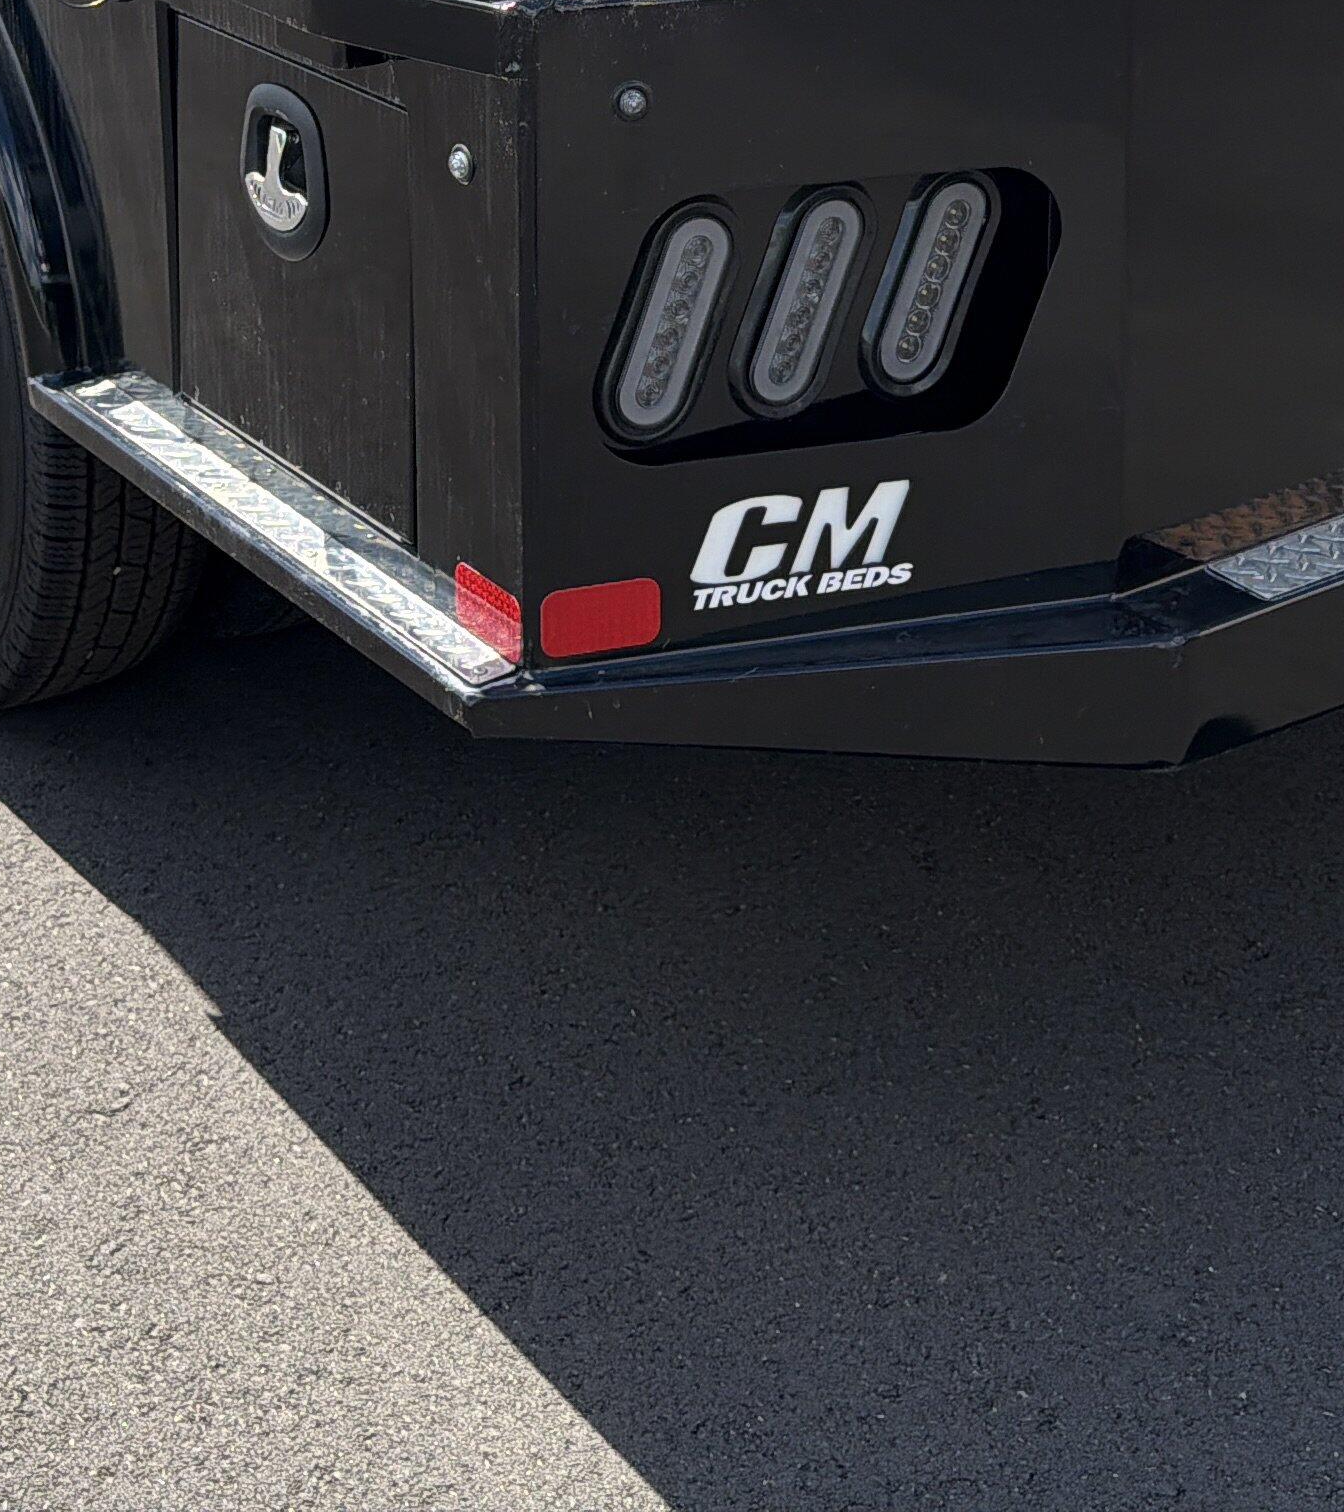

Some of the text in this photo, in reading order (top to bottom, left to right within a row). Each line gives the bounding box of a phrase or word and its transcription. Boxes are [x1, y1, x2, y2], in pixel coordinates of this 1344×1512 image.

[689, 479, 910, 585] CM
[693, 562, 914, 611] TRUCK BEDS
